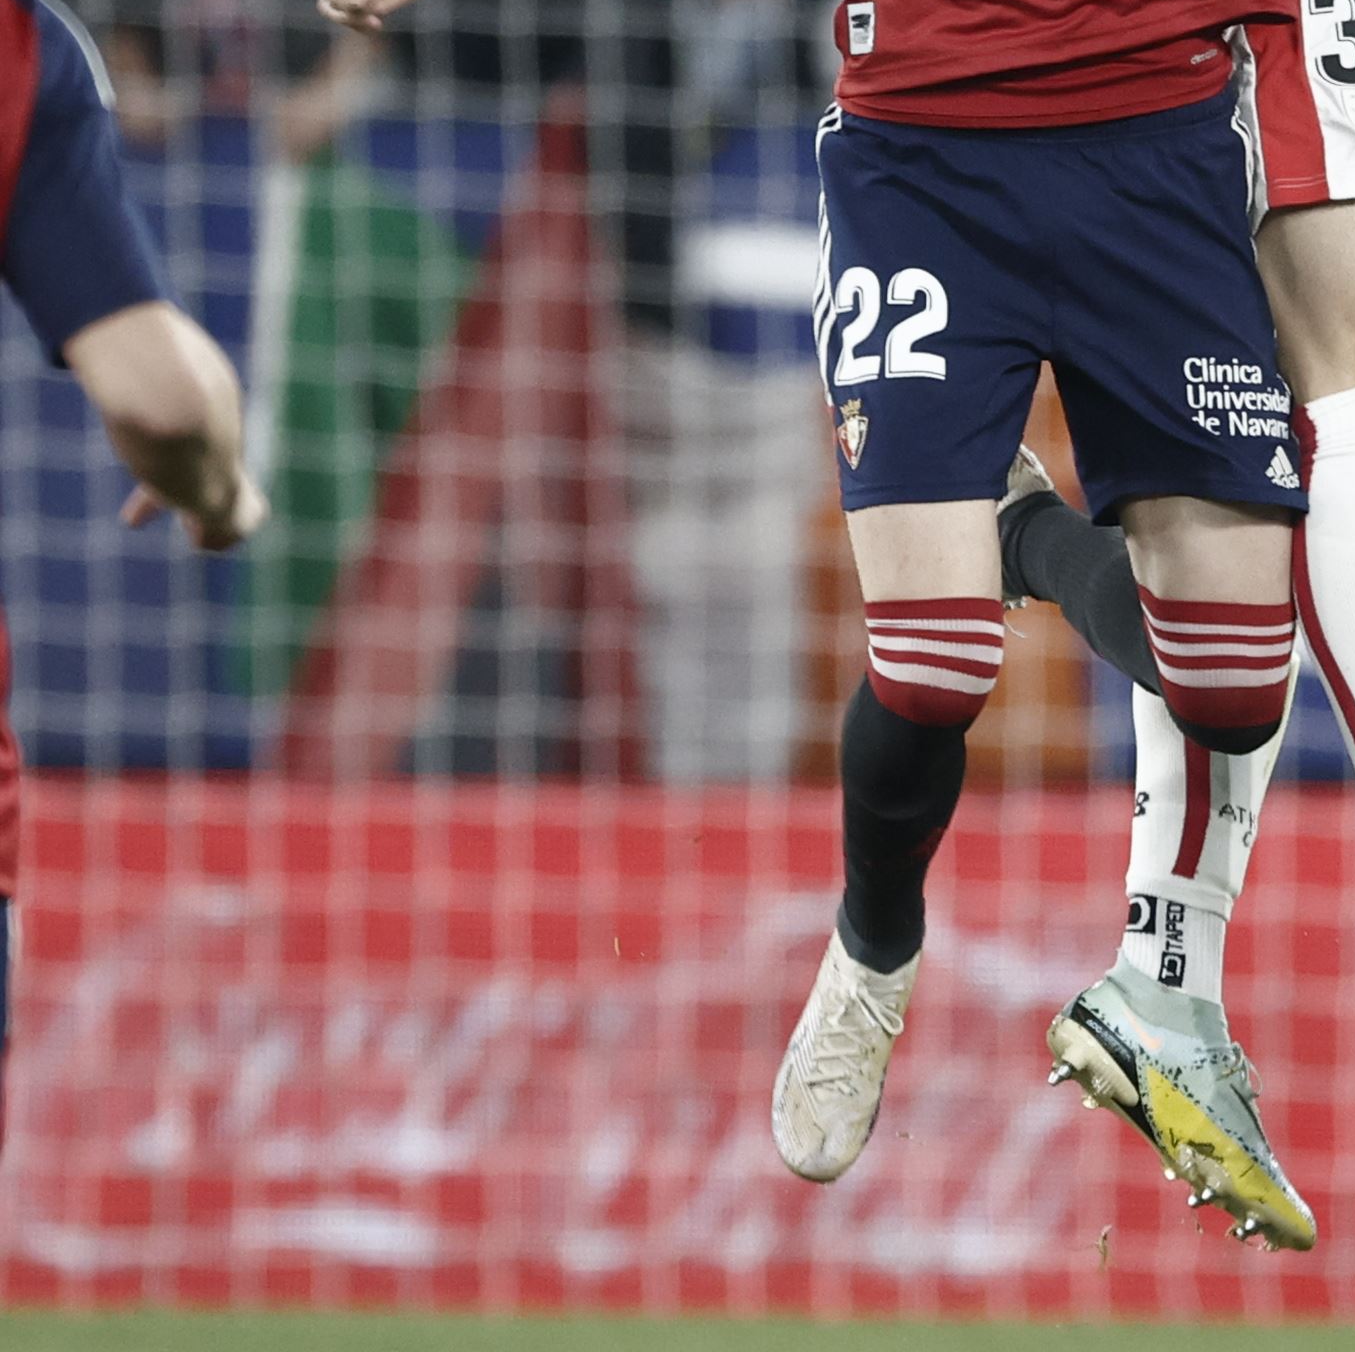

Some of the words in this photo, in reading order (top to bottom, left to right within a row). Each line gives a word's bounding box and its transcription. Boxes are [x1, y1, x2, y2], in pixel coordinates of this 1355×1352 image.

[834, 266, 949, 387] 22
[1183, 356, 1263, 384] Clínica
[1186, 383, 1291, 415] Universida
